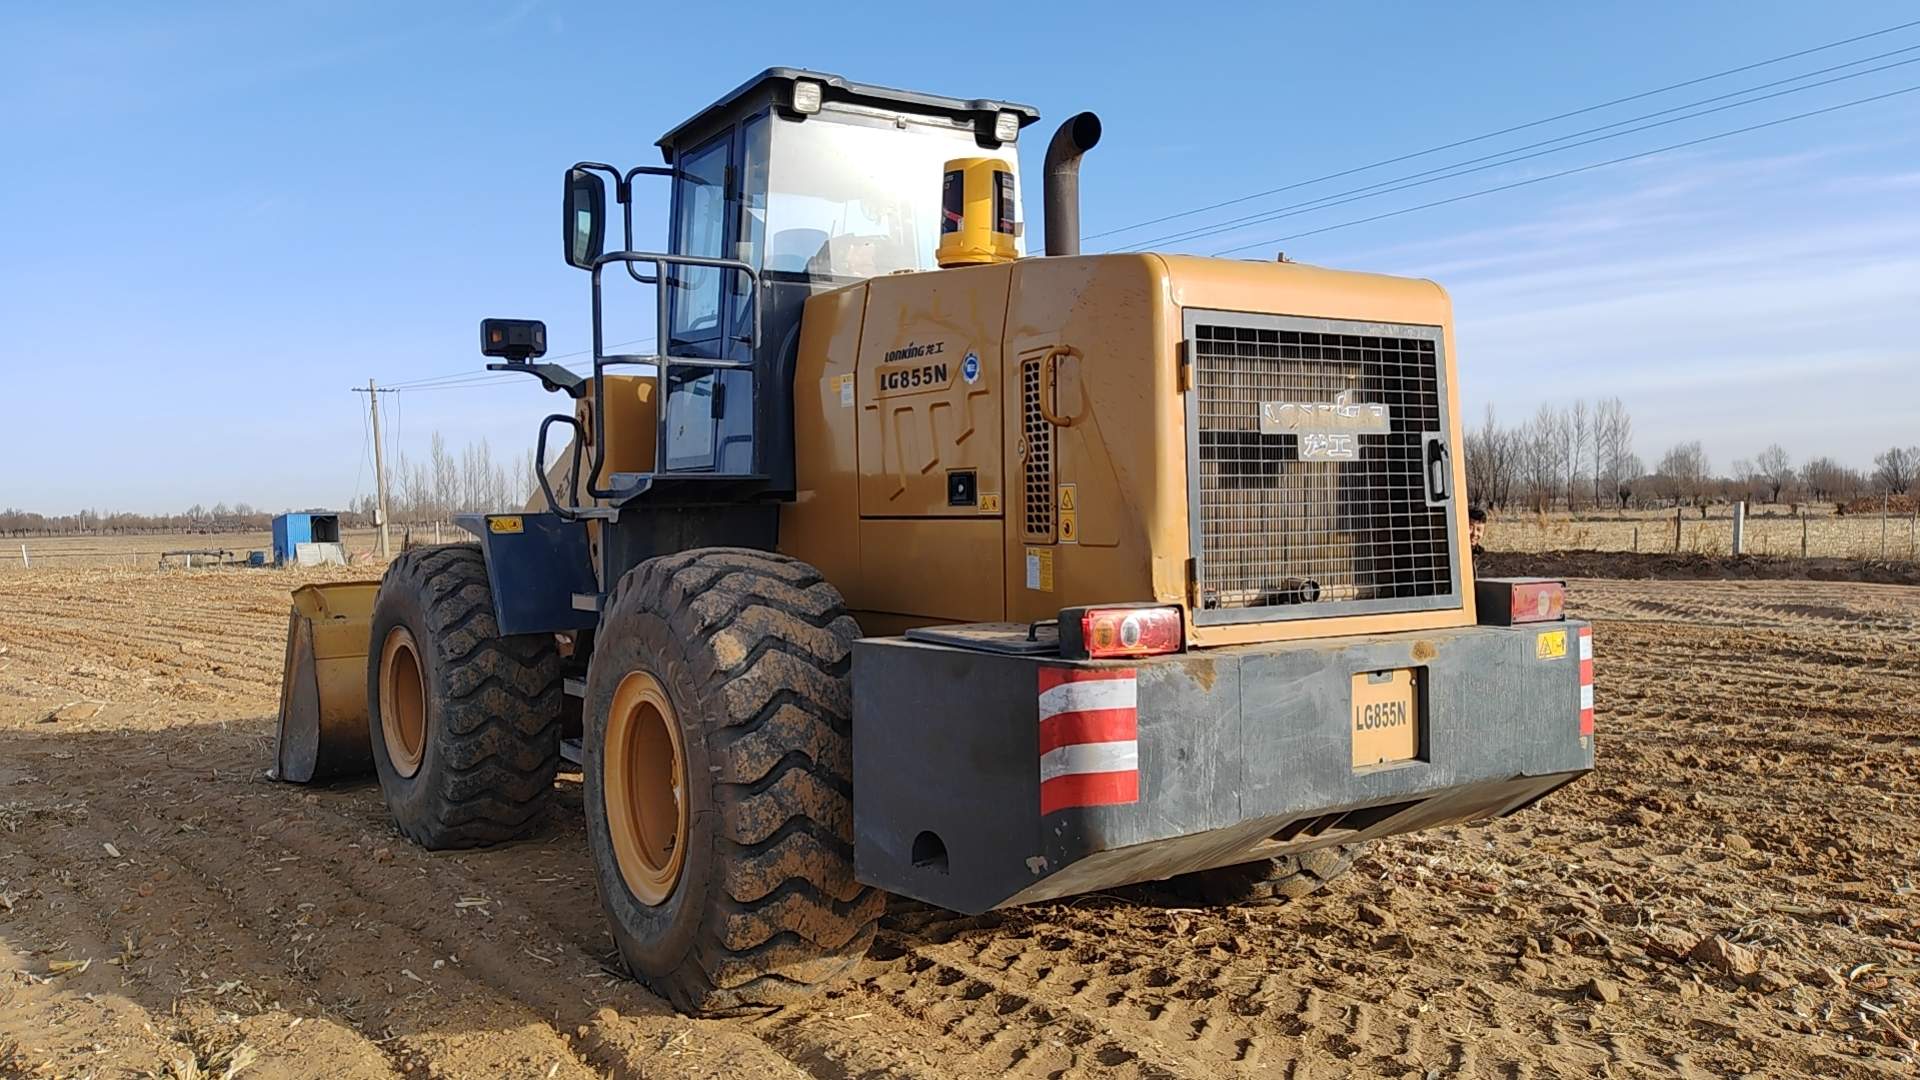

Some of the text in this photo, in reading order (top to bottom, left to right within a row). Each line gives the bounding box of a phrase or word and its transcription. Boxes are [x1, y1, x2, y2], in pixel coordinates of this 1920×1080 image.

[925, 342, 945, 357] 龙工
[880, 364, 947, 391] LG855N
[1356, 701, 1406, 730] LG855N
